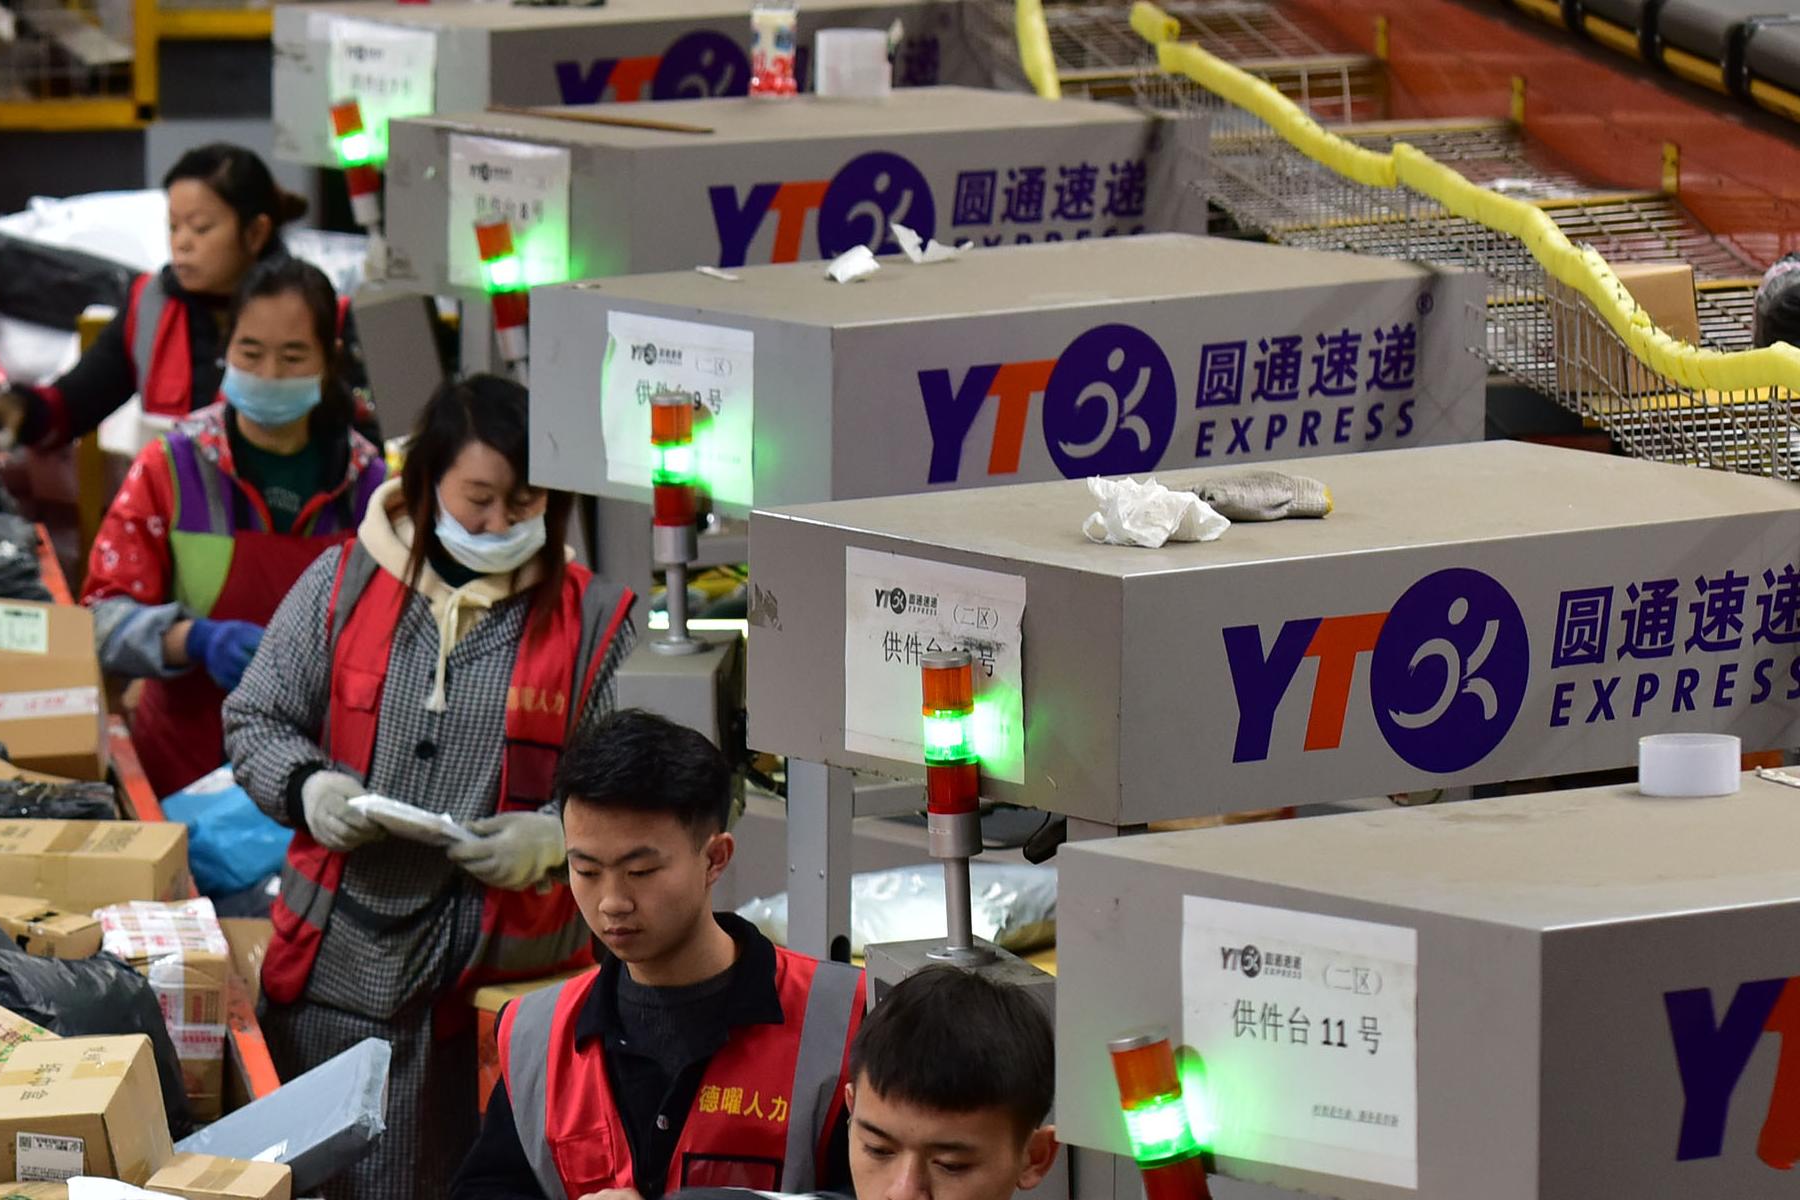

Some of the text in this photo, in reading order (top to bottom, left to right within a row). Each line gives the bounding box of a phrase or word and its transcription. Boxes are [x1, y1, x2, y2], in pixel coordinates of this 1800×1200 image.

[952, 160, 1147, 227] 圆通速递
[1196, 322, 1417, 408] 圆通速递
[1195, 398, 1415, 459] EXPRESS
[1551, 563, 1800, 669] 圆通速递
[1221, 567, 1530, 773] YTO
[1549, 655, 1800, 728] EXPRESS
